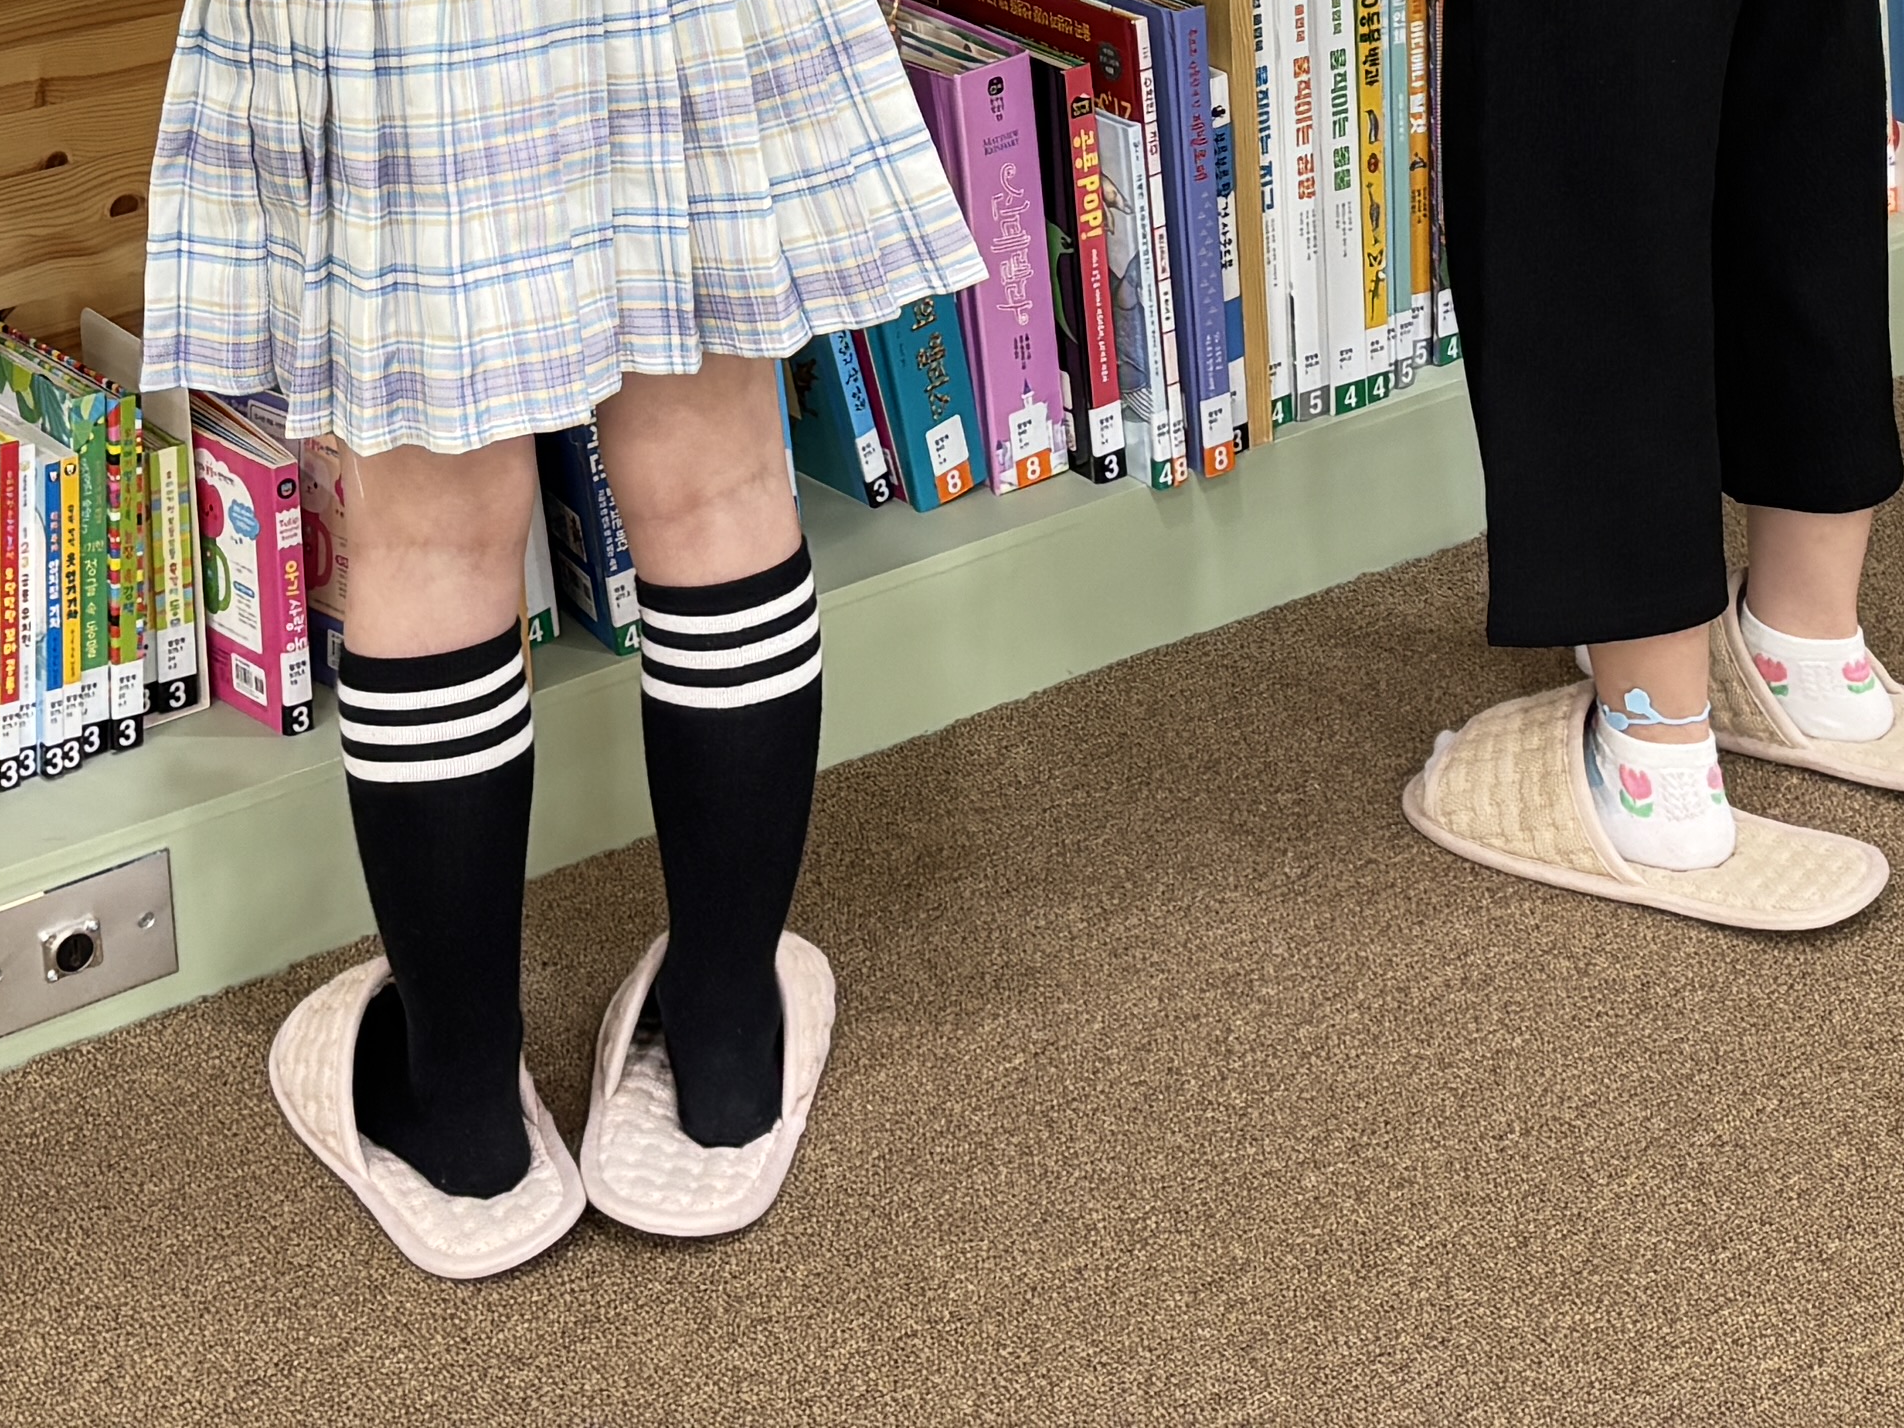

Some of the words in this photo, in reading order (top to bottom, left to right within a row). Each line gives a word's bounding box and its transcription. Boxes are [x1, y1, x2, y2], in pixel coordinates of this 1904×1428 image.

[1072, 129, 1095, 172] 공룡
[990, 161, 1032, 329] 신데렐라
[1024, 455, 1043, 482] 8
